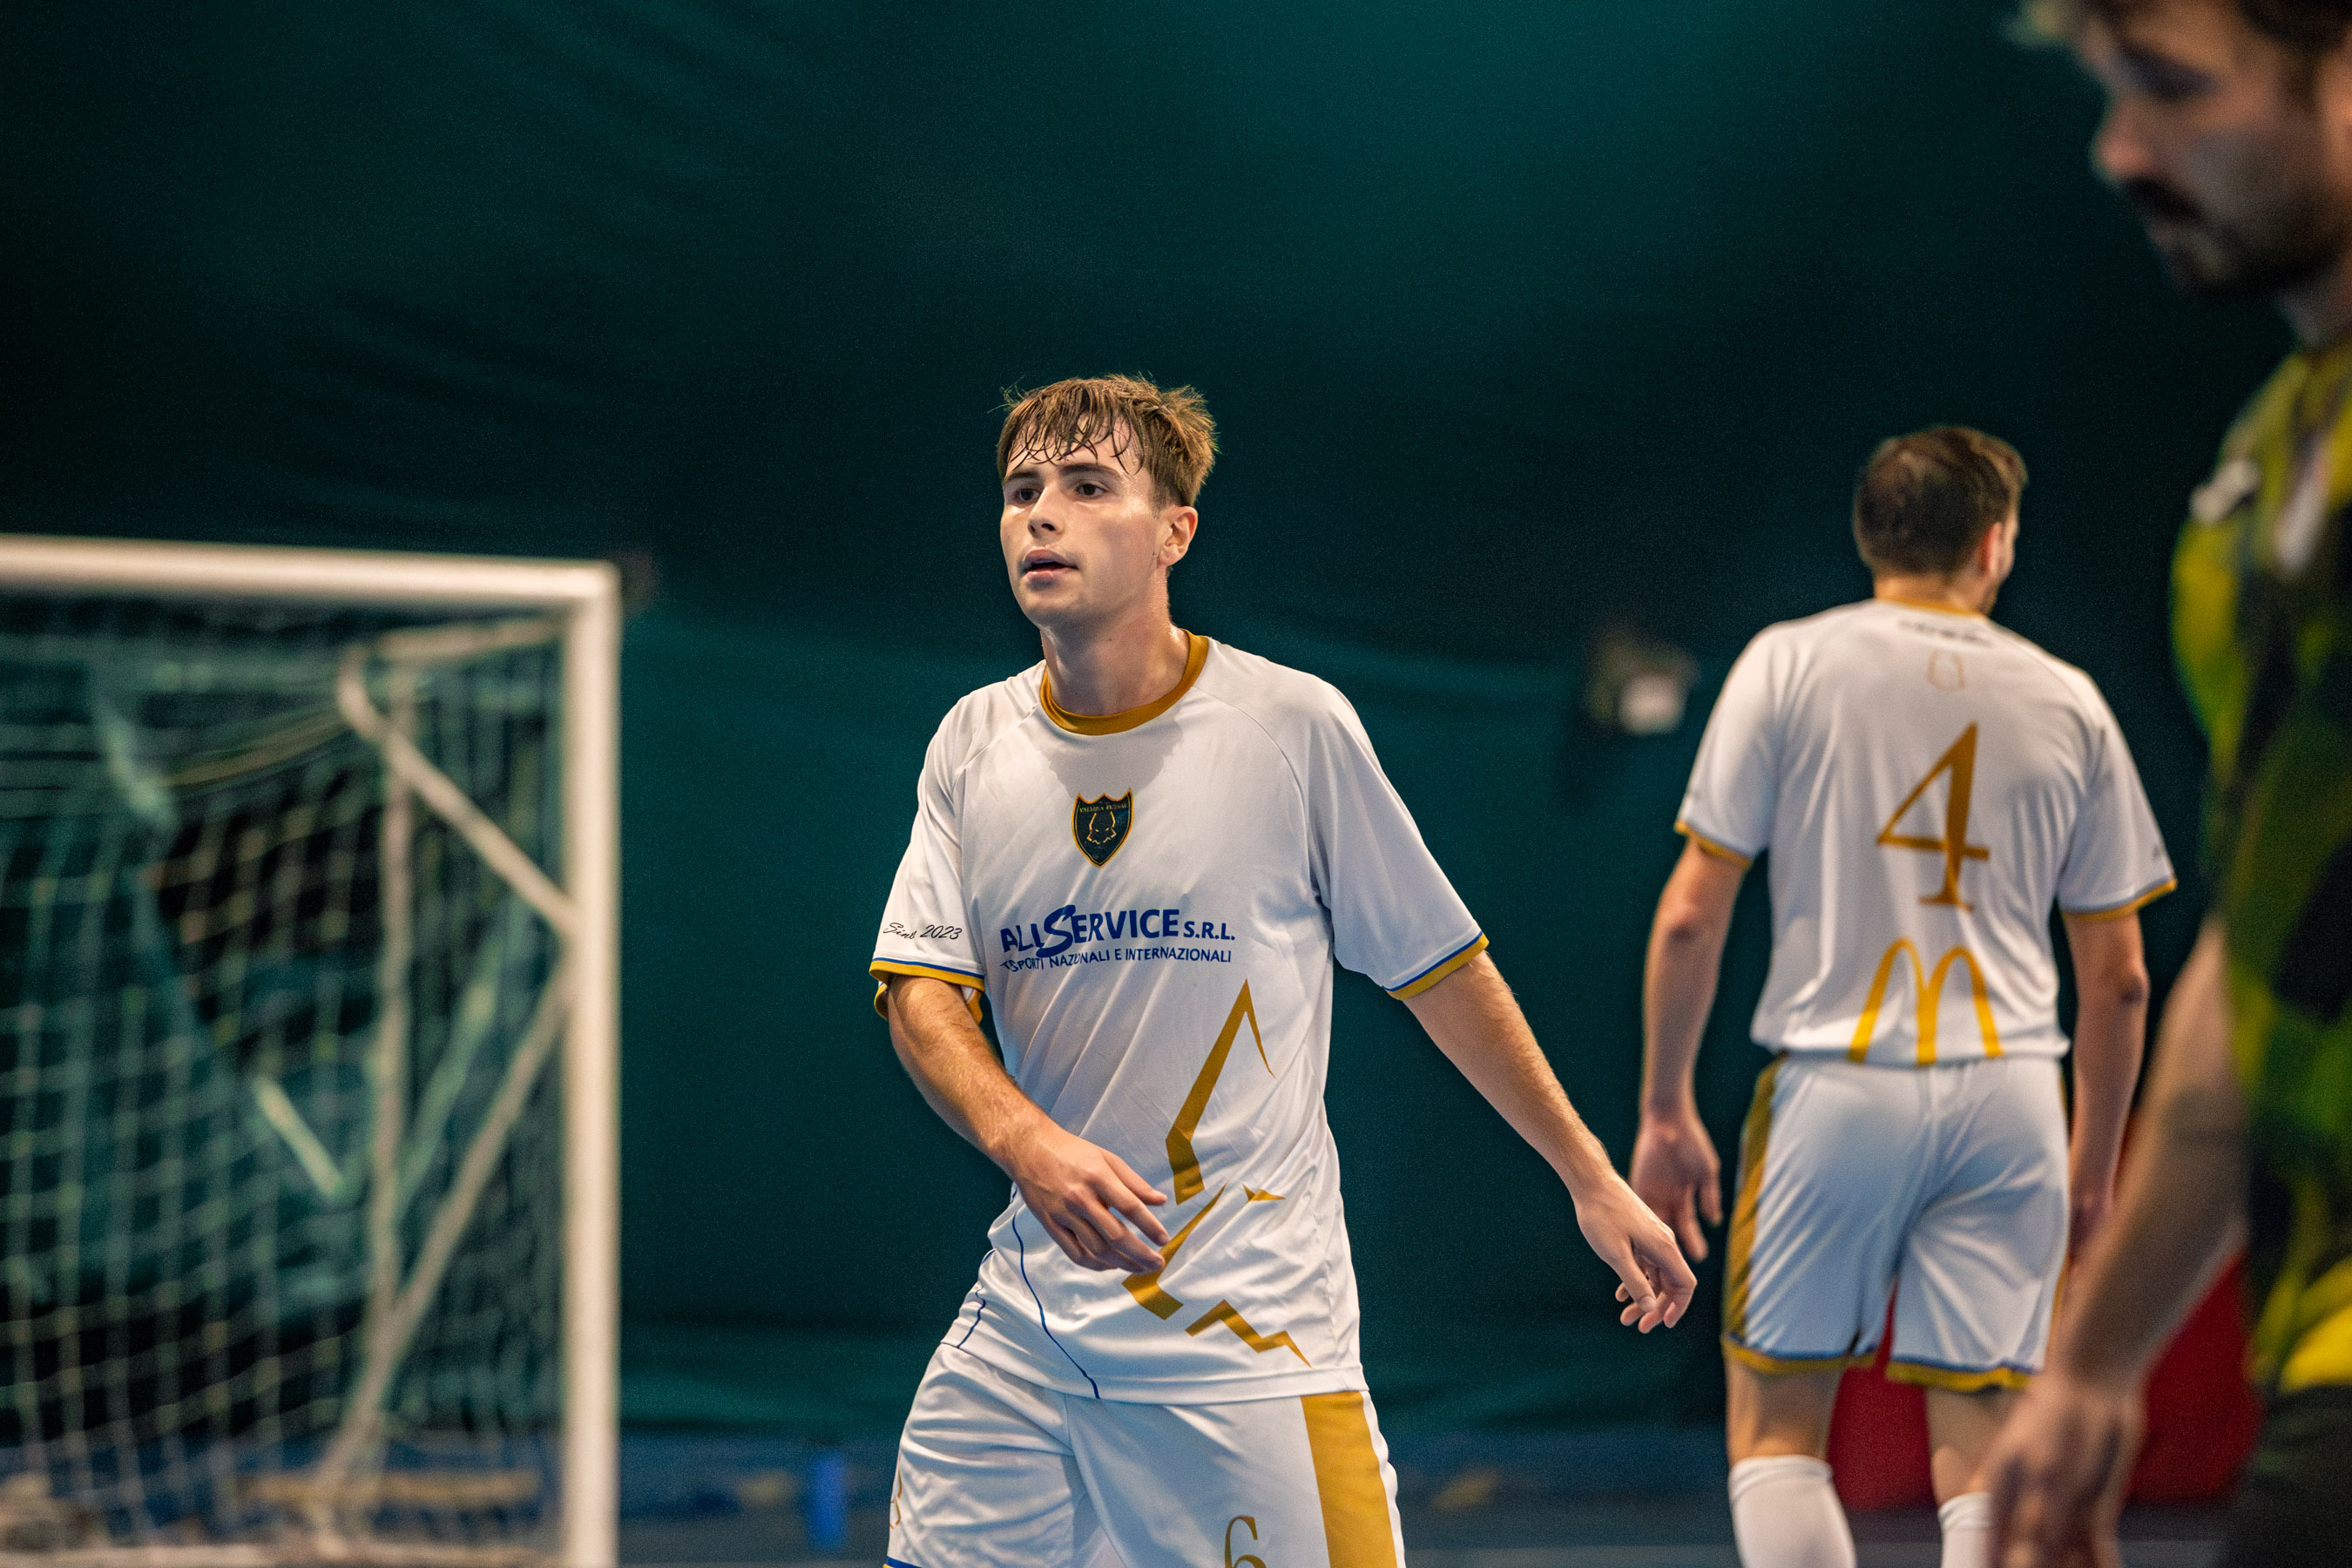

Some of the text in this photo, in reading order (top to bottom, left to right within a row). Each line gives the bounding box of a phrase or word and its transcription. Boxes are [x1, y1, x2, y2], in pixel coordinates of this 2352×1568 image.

[1877, 722, 1990, 912] 4
[919, 924, 963, 940] 2023
[1183, 920, 1236, 941] S.R.L.
[1114, 948, 1122, 961] E
[1125, 946, 1232, 963] INTERNAZIONALI
[1224, 1515, 1267, 1568] 6
